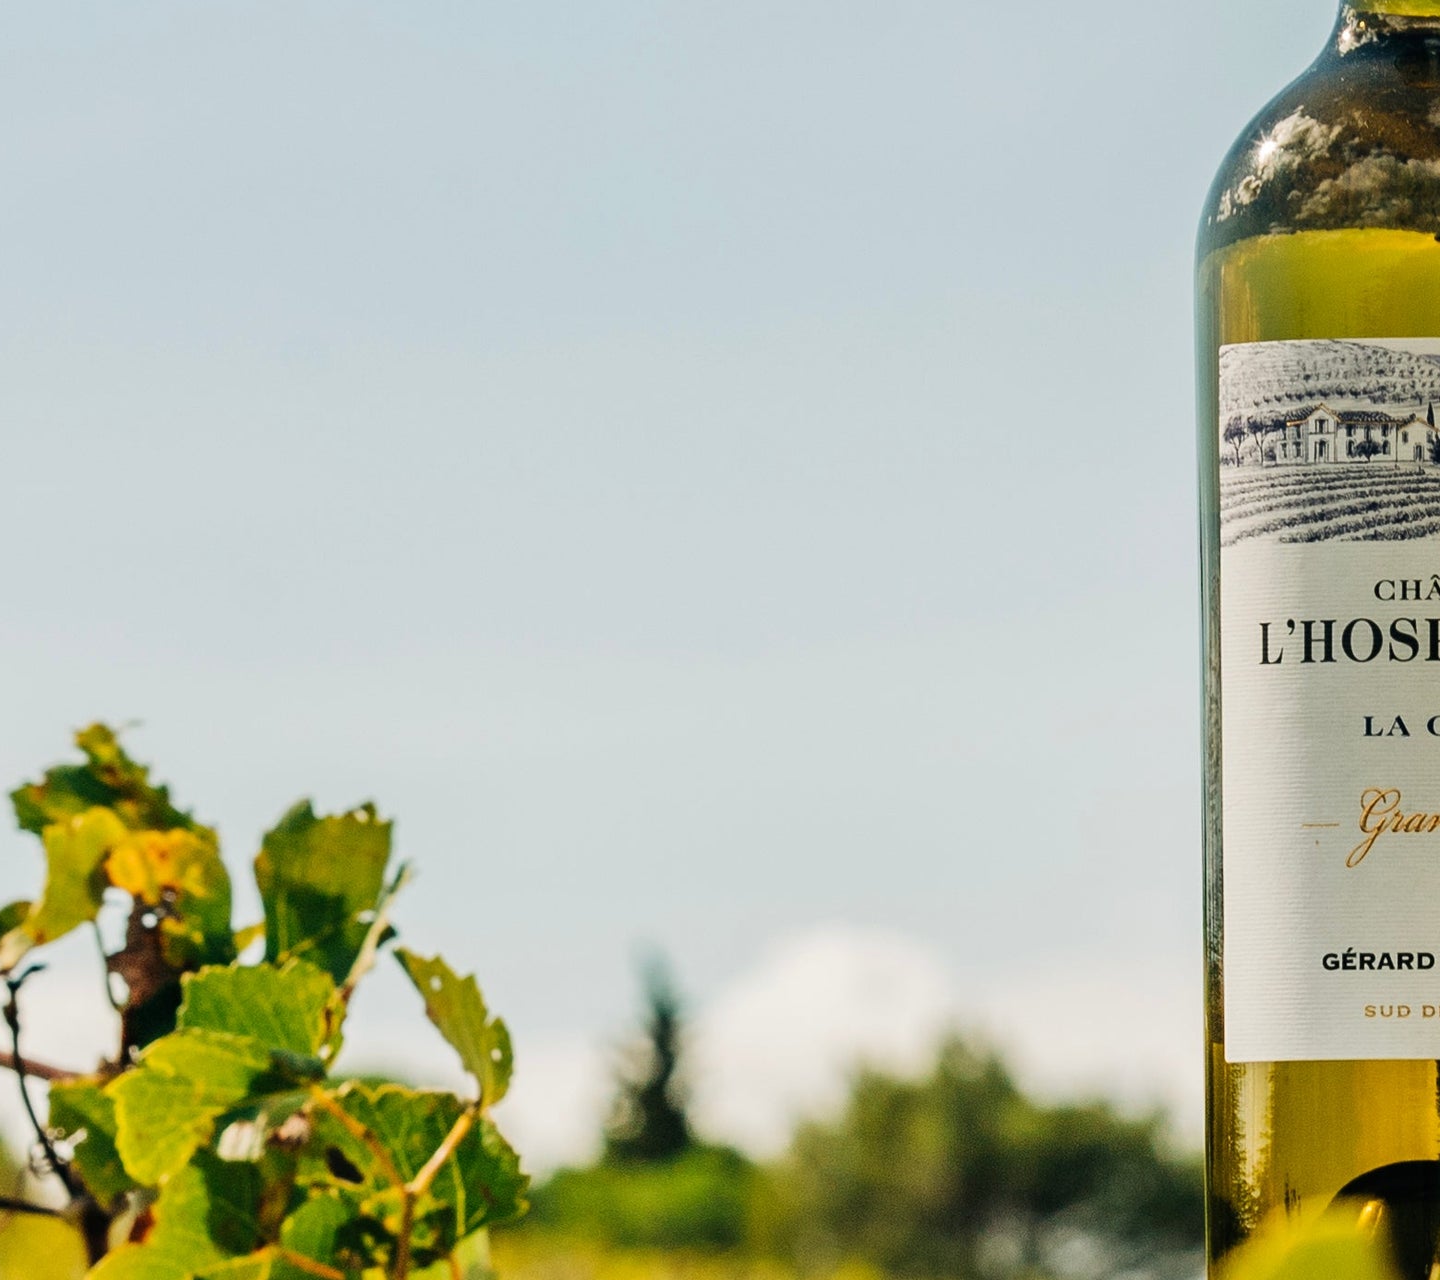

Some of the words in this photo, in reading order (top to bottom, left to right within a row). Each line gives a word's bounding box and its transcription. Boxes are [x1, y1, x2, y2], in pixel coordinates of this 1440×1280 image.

[1363, 714, 1410, 738] LA
[1321, 947, 1436, 972] GÉRARD
[1364, 1004, 1412, 1019] SUD
